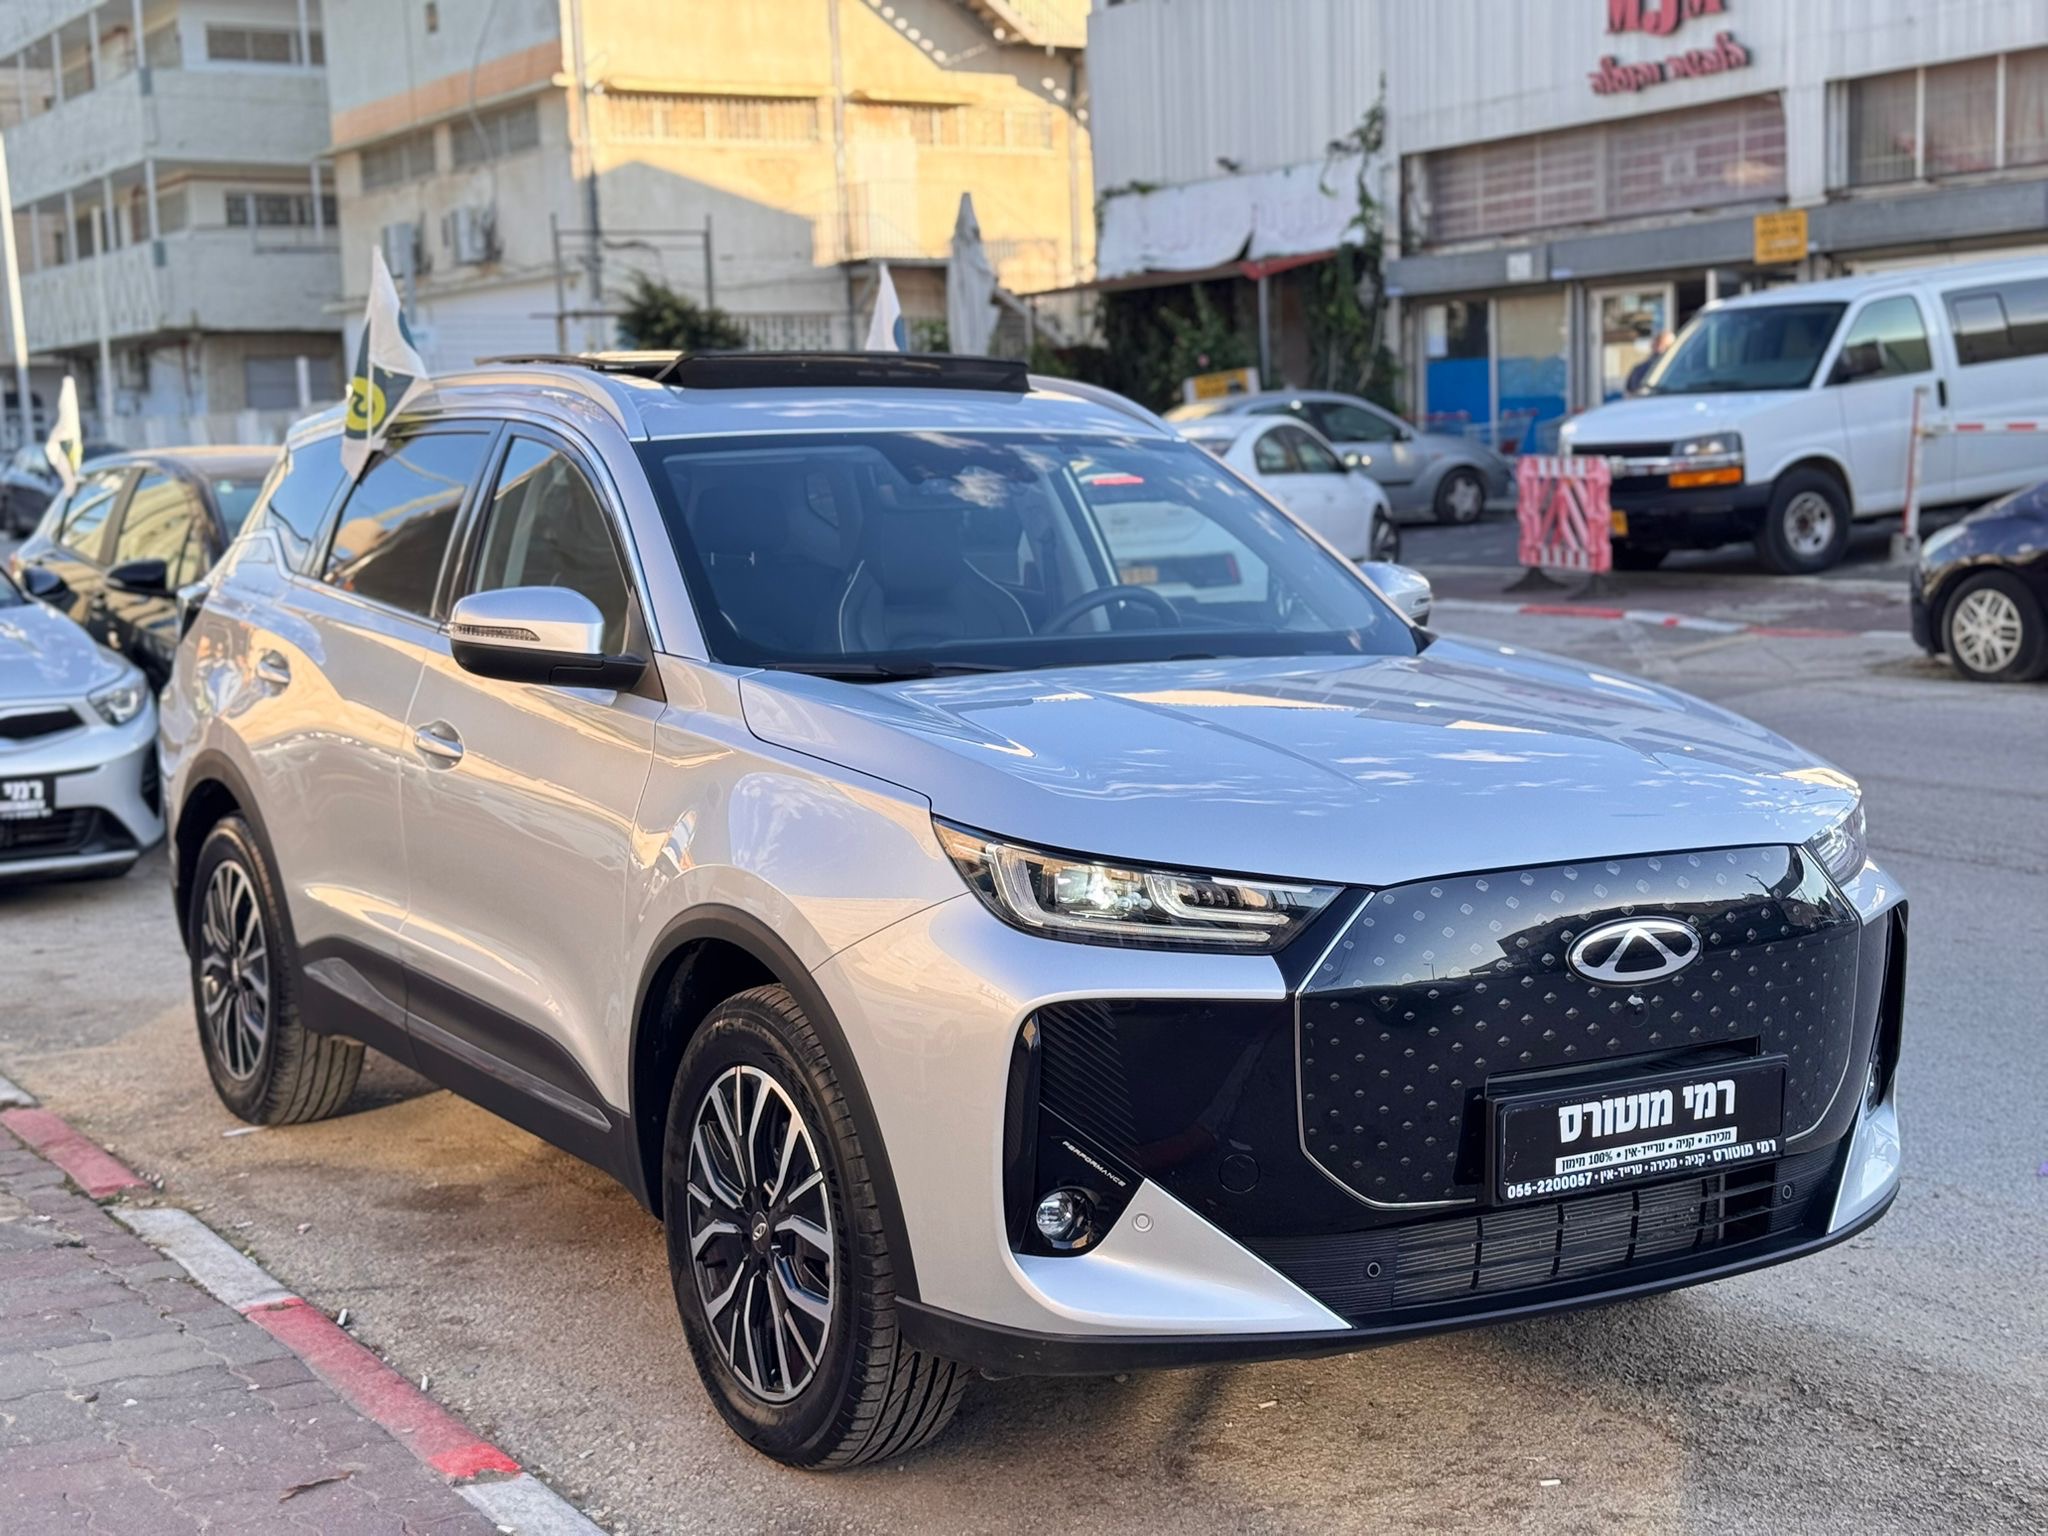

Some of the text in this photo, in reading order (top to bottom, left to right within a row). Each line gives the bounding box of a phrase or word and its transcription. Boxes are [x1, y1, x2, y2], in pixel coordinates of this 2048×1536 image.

[3, 780, 44, 800] רמי
[1558, 1079, 1736, 1143] רמי מוטורס
[1675, 1137, 1695, 1150] קניה
[1705, 1130, 1731, 1145] מכירה
[1712, 1143, 1754, 1162] מוטורס
[1756, 1138, 1777, 1154] רמי
[1562, 1156, 1586, 1171] מימון
[1588, 1150, 1613, 1166] 100%
[1650, 1157, 1678, 1172] מכירה
[1685, 1152, 1706, 1167] קניה
[1507, 1171, 1593, 1199] 055-2200057
